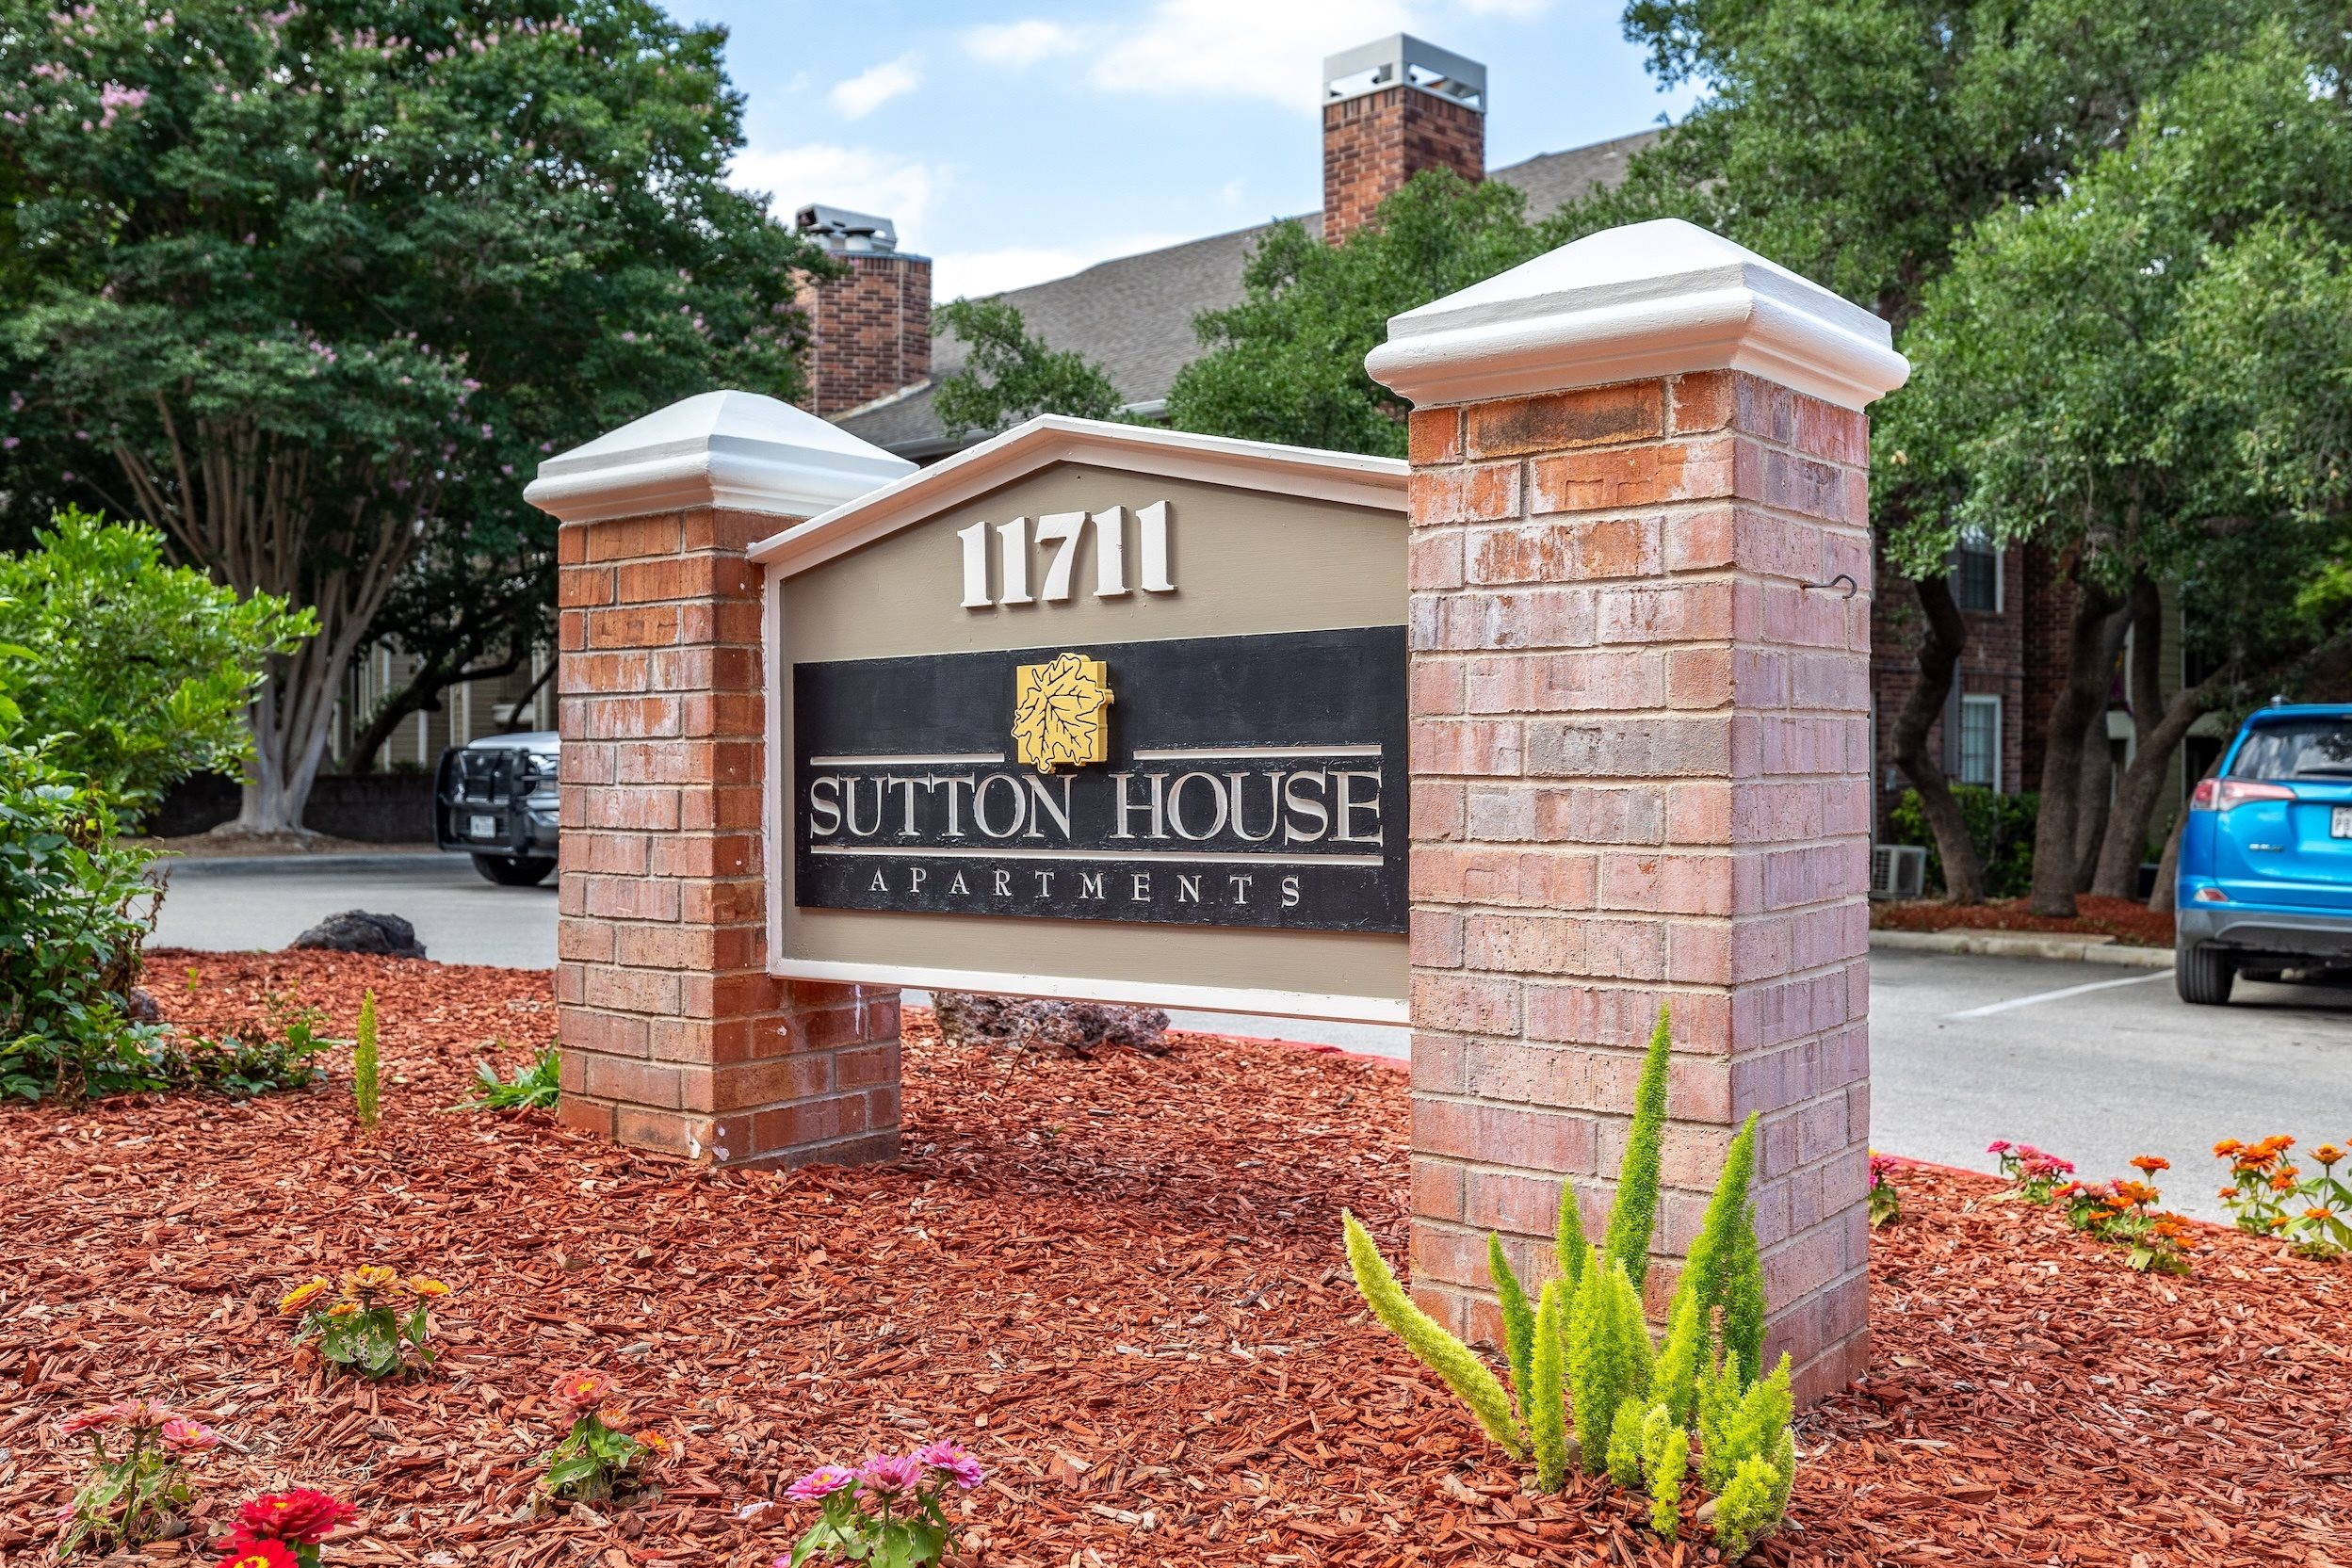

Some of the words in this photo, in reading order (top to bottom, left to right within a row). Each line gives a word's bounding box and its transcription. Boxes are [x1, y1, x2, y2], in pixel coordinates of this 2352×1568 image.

[957, 500, 1177, 607] 11711
[810, 772, 1072, 839] SUTTON
[1110, 768, 1384, 848] HOUSE
[869, 866, 1301, 907] APARTMENTS
